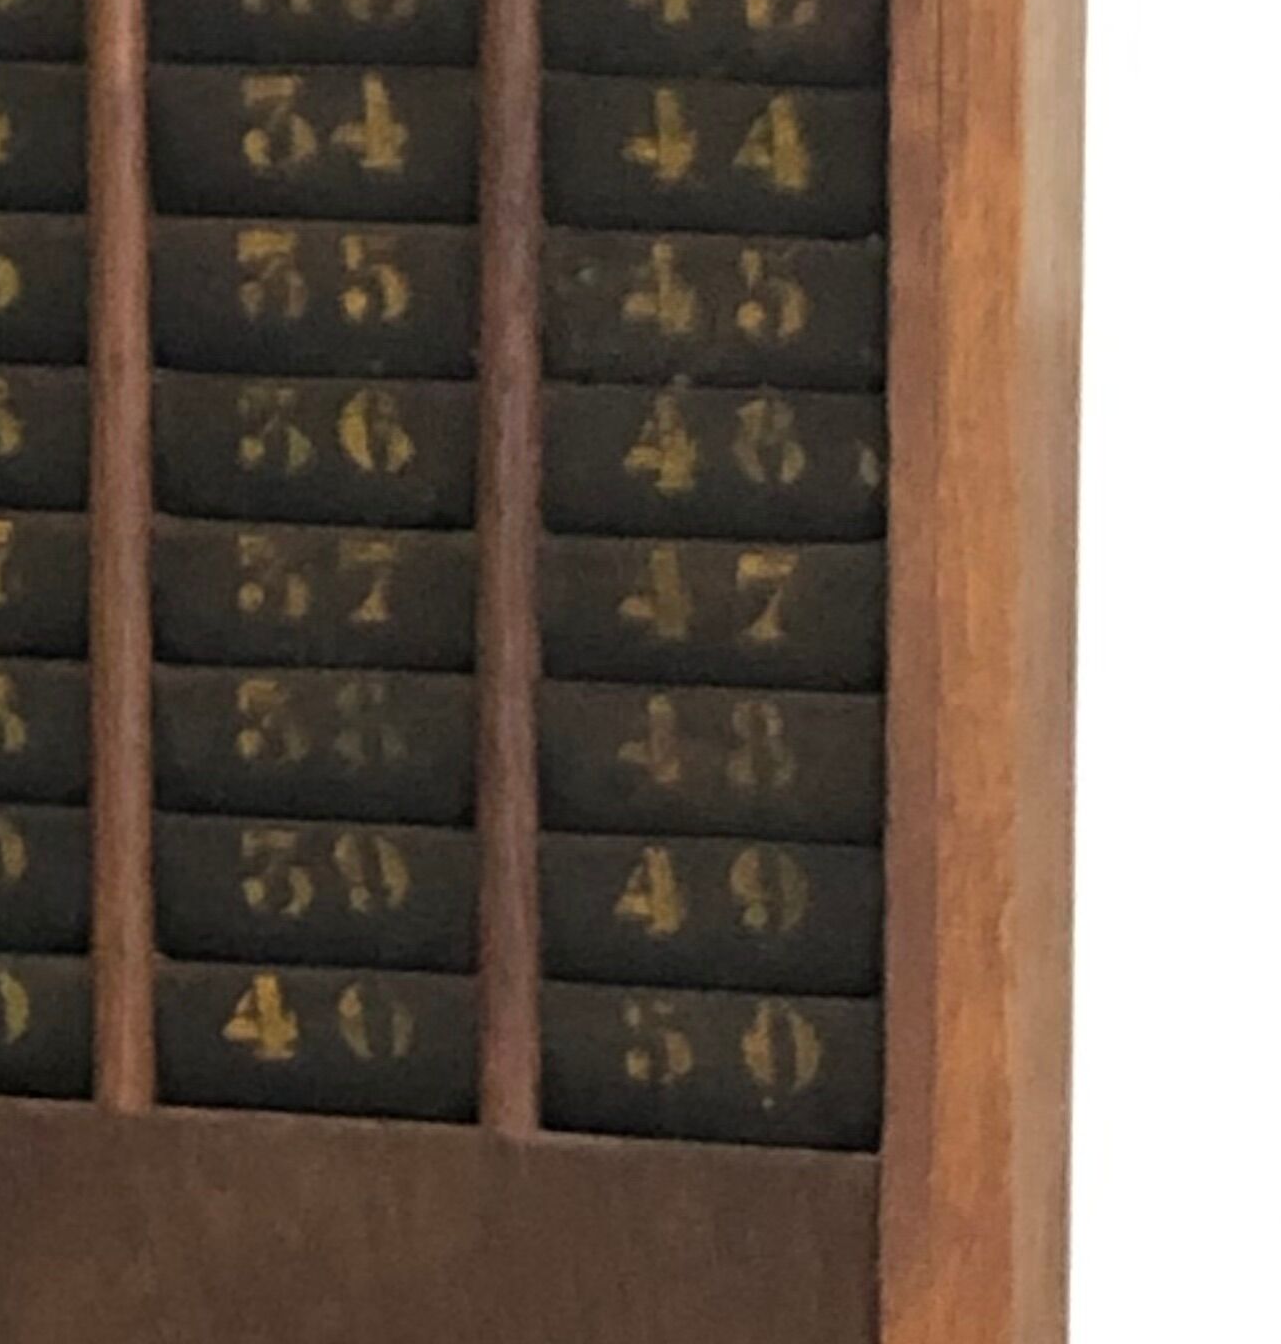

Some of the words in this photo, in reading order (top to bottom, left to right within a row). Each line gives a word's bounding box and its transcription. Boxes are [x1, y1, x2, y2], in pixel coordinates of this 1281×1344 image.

[241, 71, 408, 172] 34
[622, 87, 812, 191] 44
[237, 228, 411, 322] 35
[622, 240, 808, 340] 45
[235, 388, 416, 476] 36
[235, 533, 397, 622] 37
[619, 545, 798, 642] 47
[613, 845, 810, 940] 49
[221, 975, 416, 1061] 40
[621, 999, 826, 1092] 50
